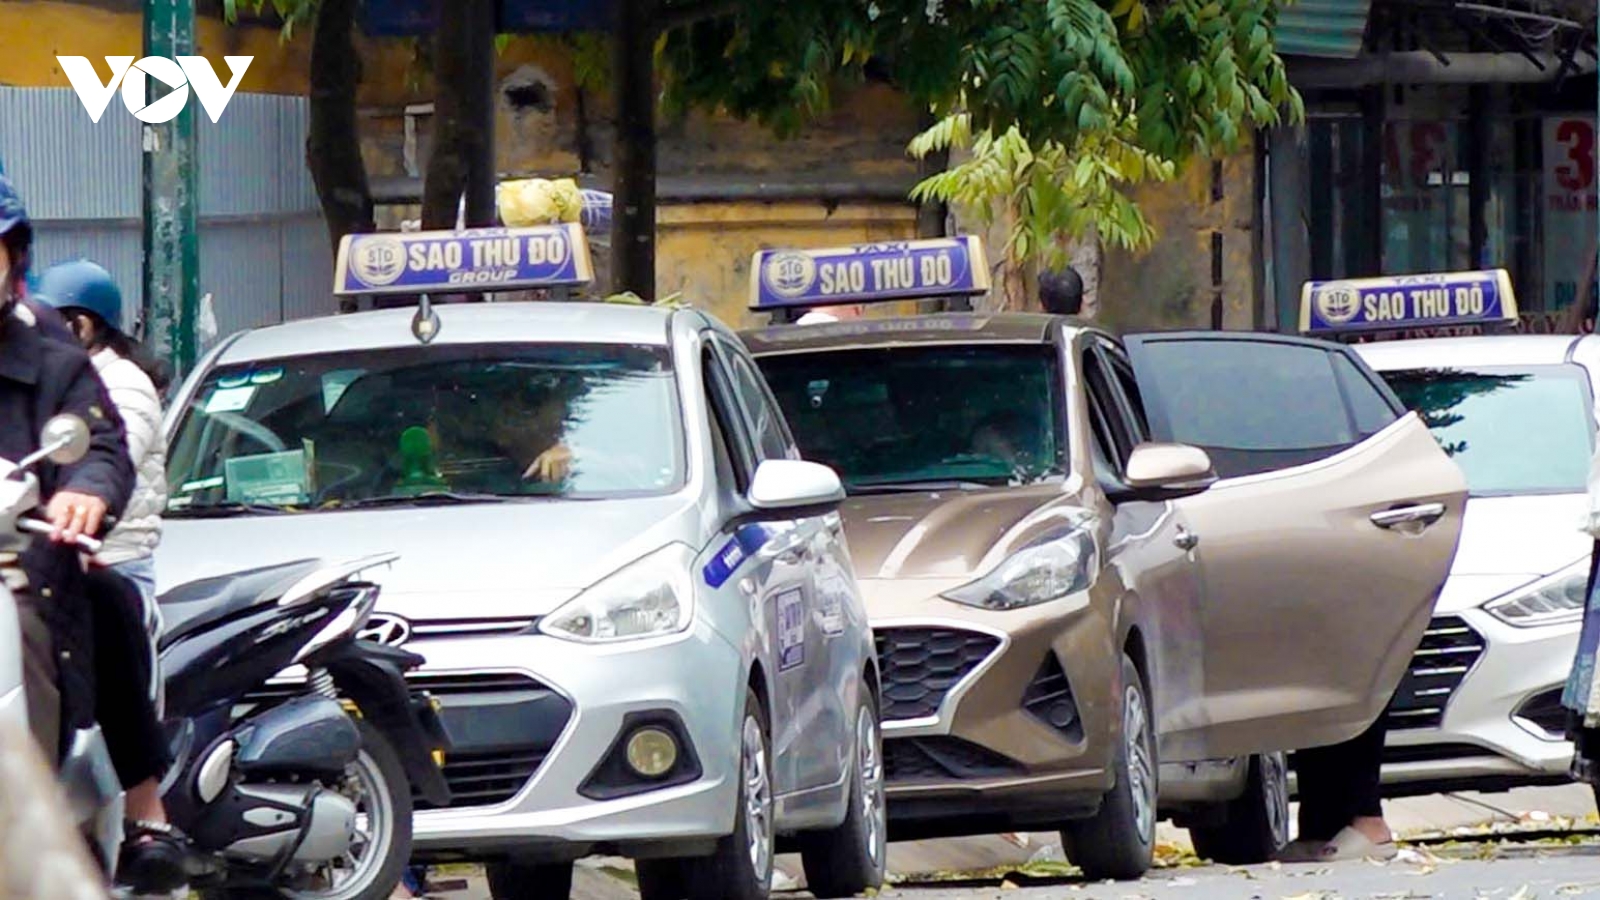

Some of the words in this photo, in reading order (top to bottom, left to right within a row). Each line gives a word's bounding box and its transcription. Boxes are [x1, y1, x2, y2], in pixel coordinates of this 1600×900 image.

[408, 238, 463, 272] SAO
[528, 232, 565, 266] ĐÔ
[852, 242, 910, 254] TAXI
[447, 268, 518, 284] GROUP
[819, 261, 865, 295] SAO
[870, 251, 915, 290] THỦ
[921, 249, 952, 287] ĐÔ
[1363, 291, 1406, 322] SAO
[1410, 283, 1449, 319] THỦ
[1454, 282, 1484, 315] ĐÔ
